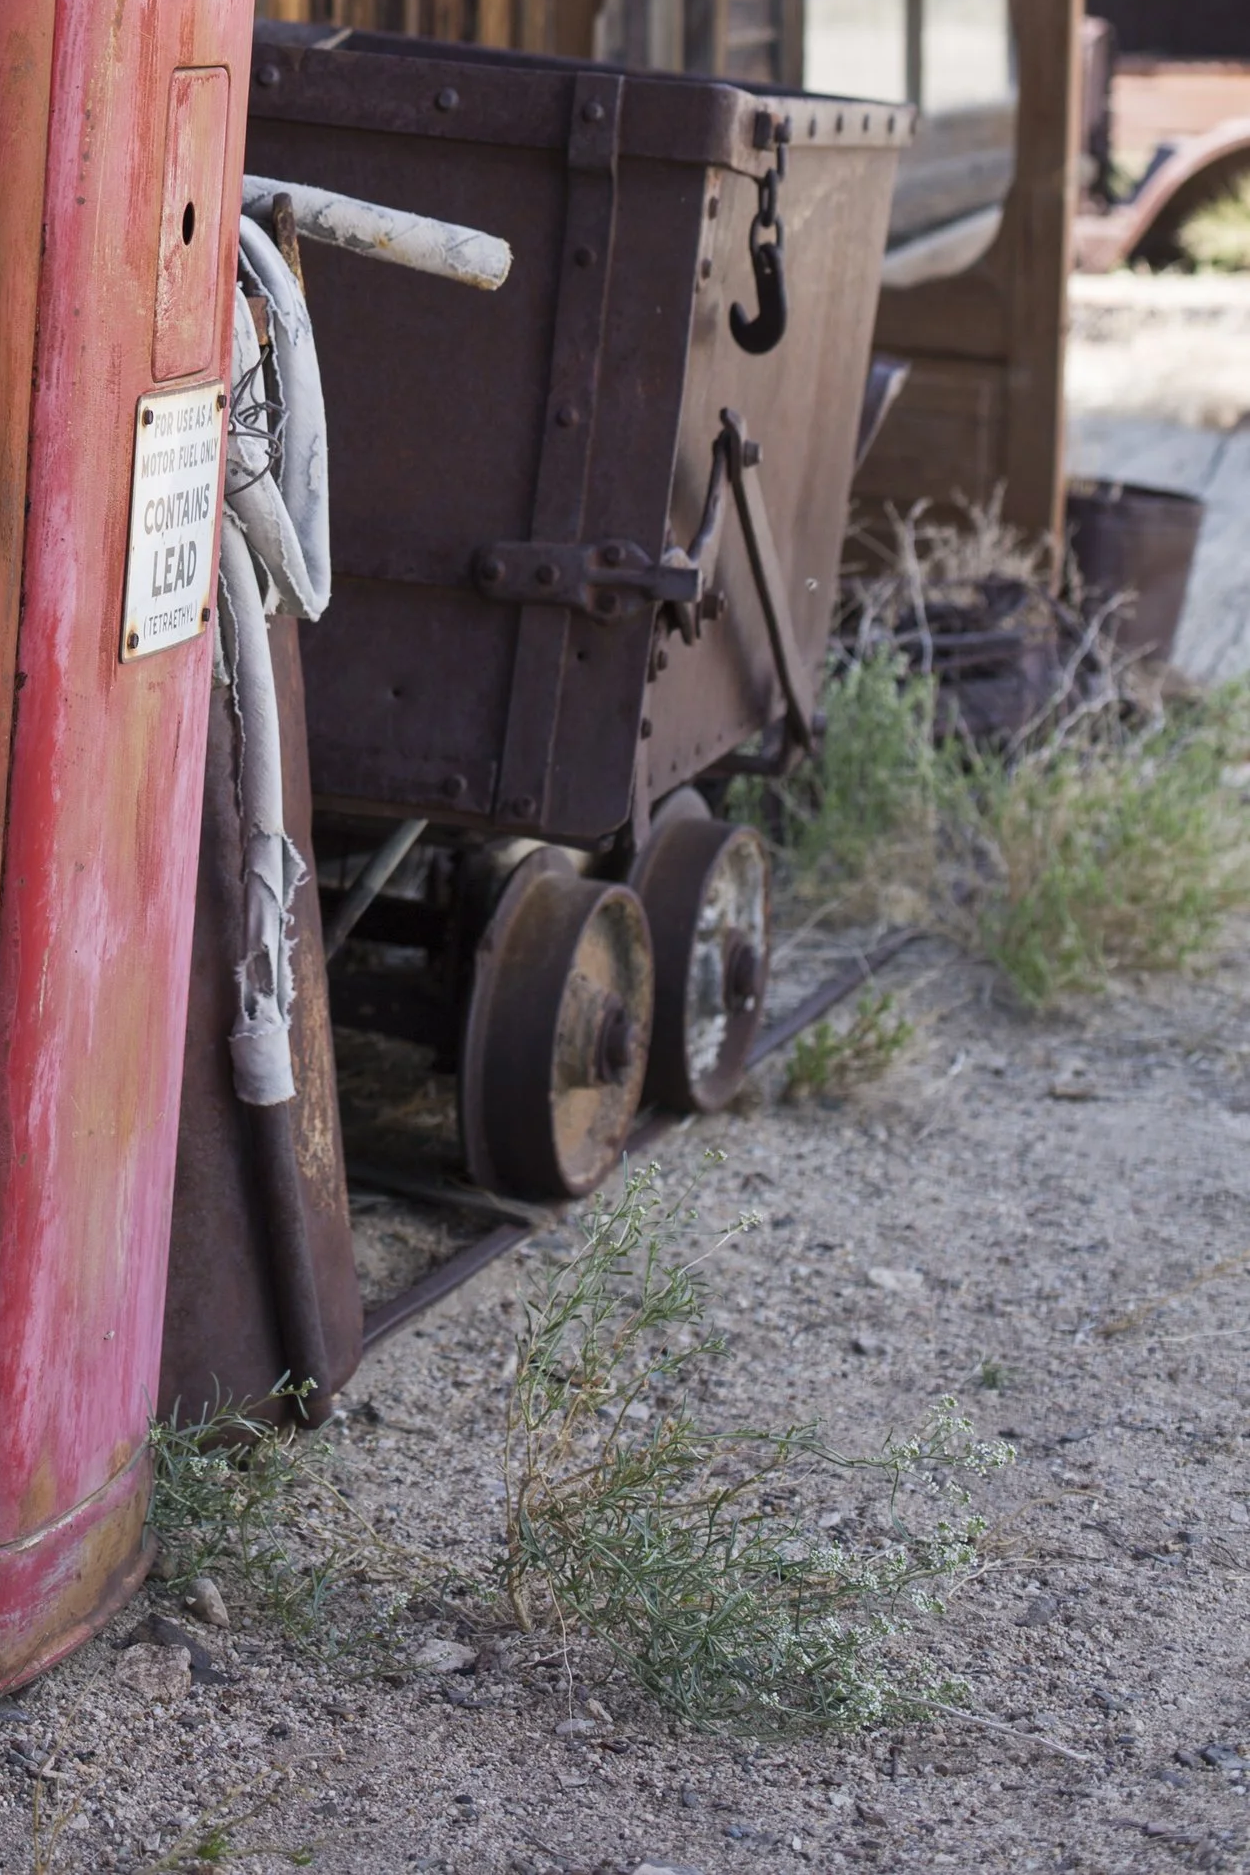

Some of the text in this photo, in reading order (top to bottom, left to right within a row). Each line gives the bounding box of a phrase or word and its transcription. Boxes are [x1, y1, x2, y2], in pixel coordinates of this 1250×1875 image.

[154, 401, 213, 439] FOR USE AS A
[141, 436, 219, 479] MOTOR FUEL ONLY
[143, 482, 211, 536] CONTAINS
[151, 540, 198, 598] LEAD
[143, 599, 198, 640] (TETRAETHYL)
